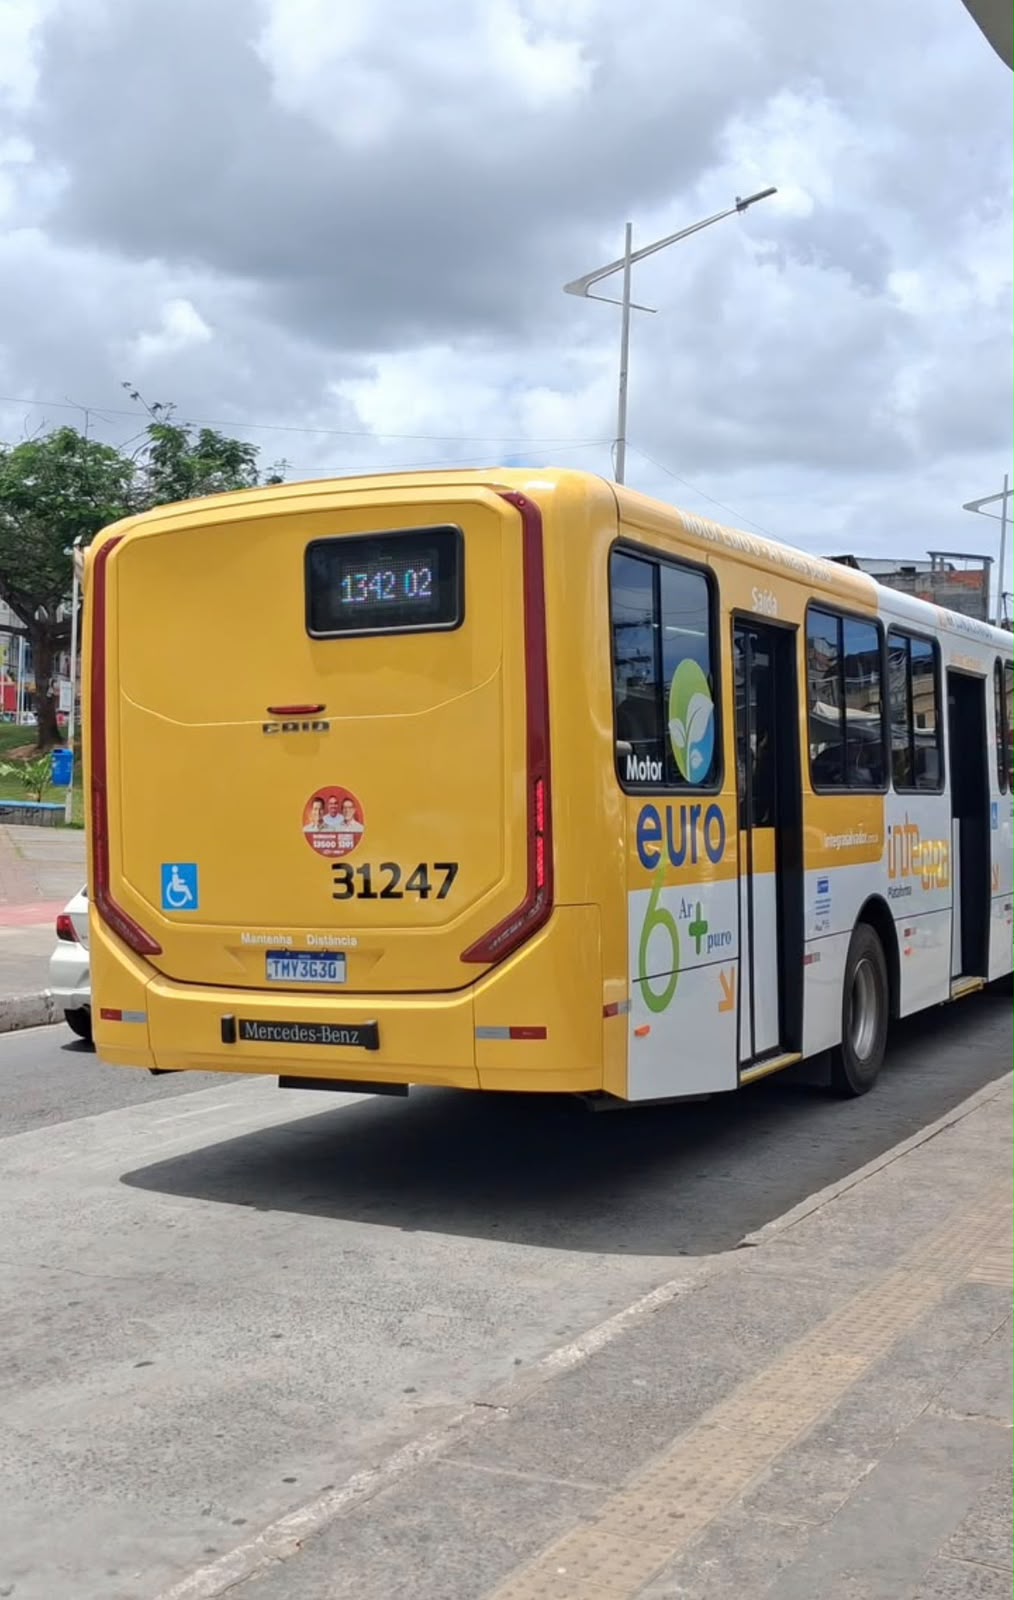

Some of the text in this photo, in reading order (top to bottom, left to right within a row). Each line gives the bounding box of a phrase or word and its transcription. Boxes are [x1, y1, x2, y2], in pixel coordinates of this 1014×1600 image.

[341, 568, 432, 602] 1342 02
[626, 755, 663, 781] Motor
[636, 803, 726, 870] euro
[331, 862, 459, 900] 31247
[241, 932, 358, 946] Mantenha Distância
[638, 847, 680, 1013] 6
[678, 896, 693, 920] Ar
[706, 929, 732, 954] puro
[245, 1021, 360, 1045] Mercedes-Benz
